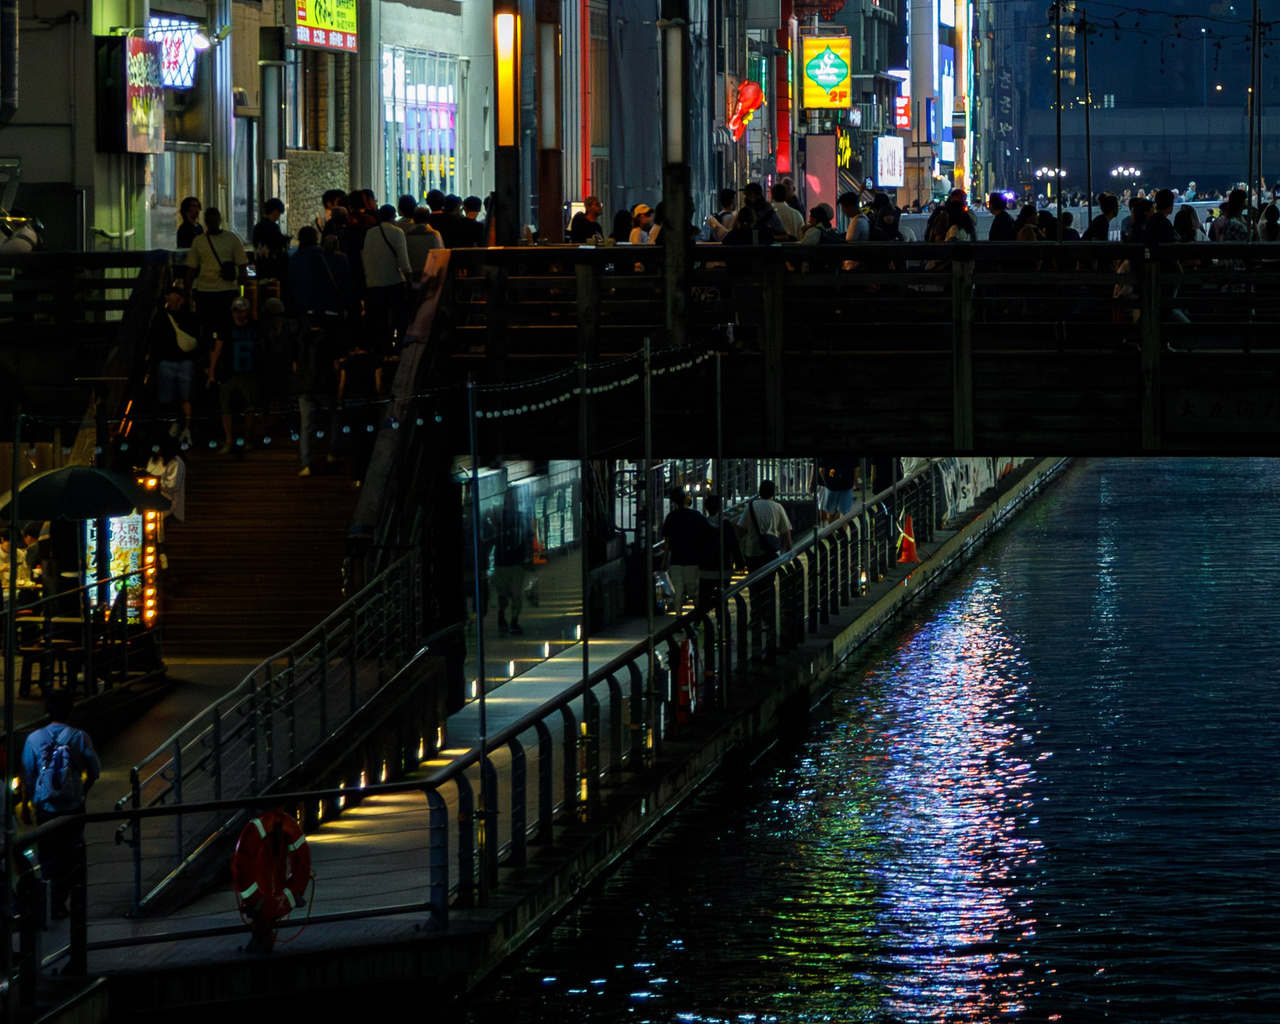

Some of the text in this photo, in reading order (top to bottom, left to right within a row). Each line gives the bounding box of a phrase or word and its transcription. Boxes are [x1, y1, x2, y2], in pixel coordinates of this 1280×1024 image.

[829, 90, 848, 104] 2F
[117, 522, 139, 535] 大阪
[117, 535, 140, 547] 名物
